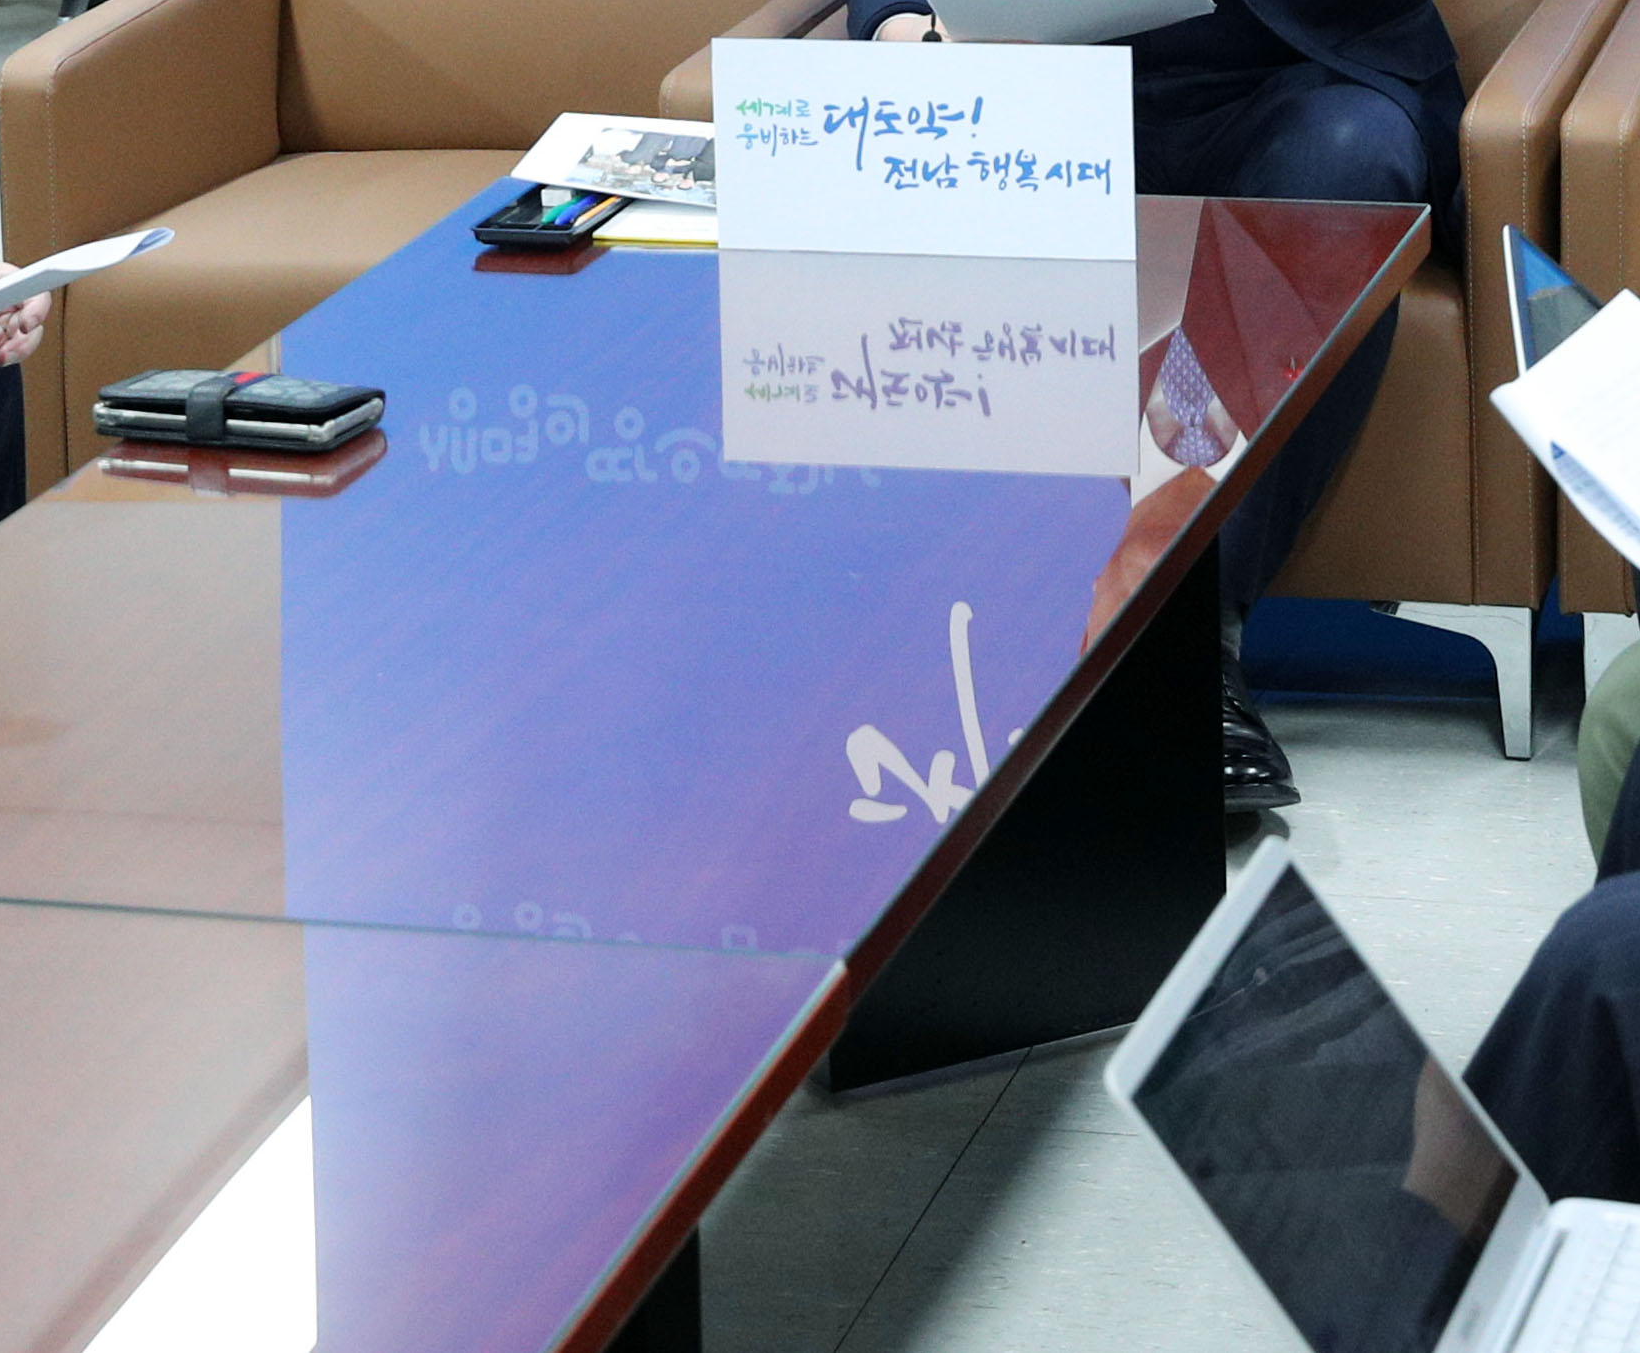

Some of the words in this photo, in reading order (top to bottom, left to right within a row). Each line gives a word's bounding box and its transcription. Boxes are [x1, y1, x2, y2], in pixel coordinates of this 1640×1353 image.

[736, 97, 812, 119] 세계로
[736, 123, 819, 157] 웅비하는
[822, 95, 984, 172] 대도약!
[883, 152, 960, 191] 전남
